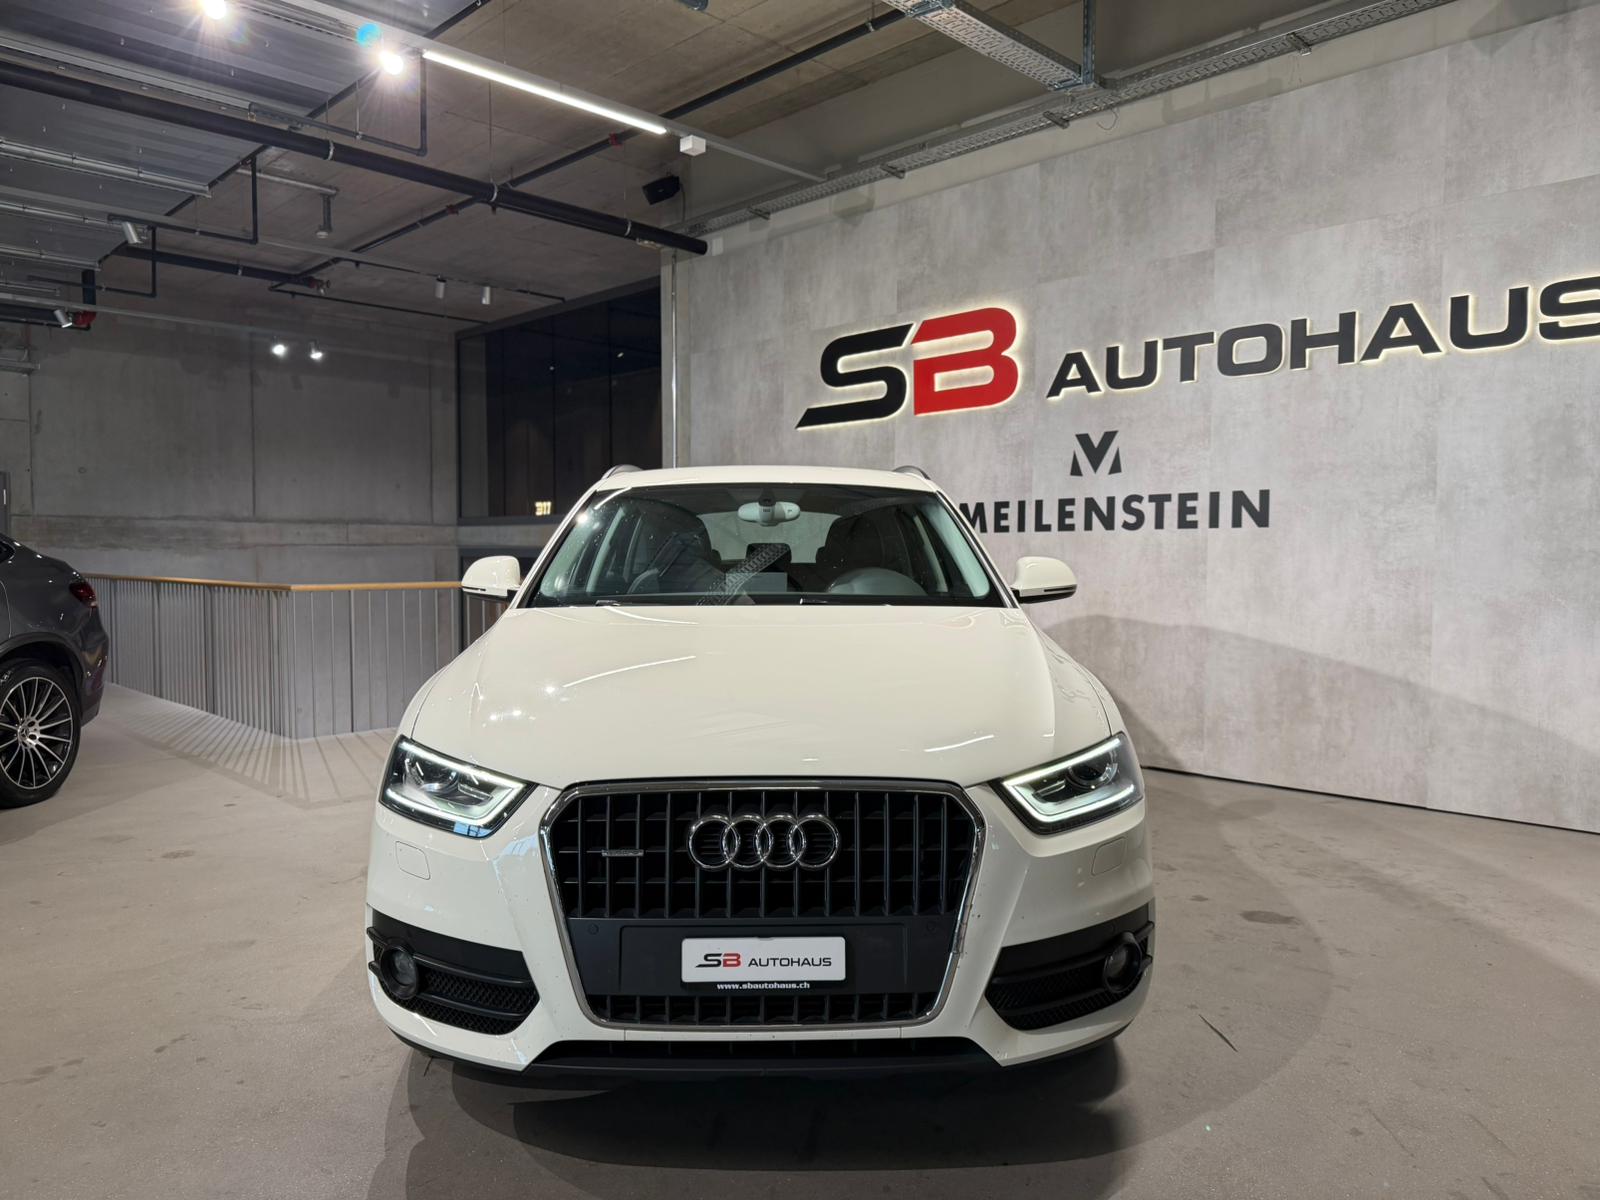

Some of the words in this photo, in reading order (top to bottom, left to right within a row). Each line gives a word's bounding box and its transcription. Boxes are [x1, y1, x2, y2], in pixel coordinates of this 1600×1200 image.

[795, 307, 1018, 429] SB
[1047, 275, 1600, 399] AUTOHAUS
[959, 489, 1270, 533] MEILENSTEIN
[695, 953, 741, 968] SB
[748, 957, 832, 967] AUTOHAUS
[717, 981, 810, 990] www.sbautohaus.ch
